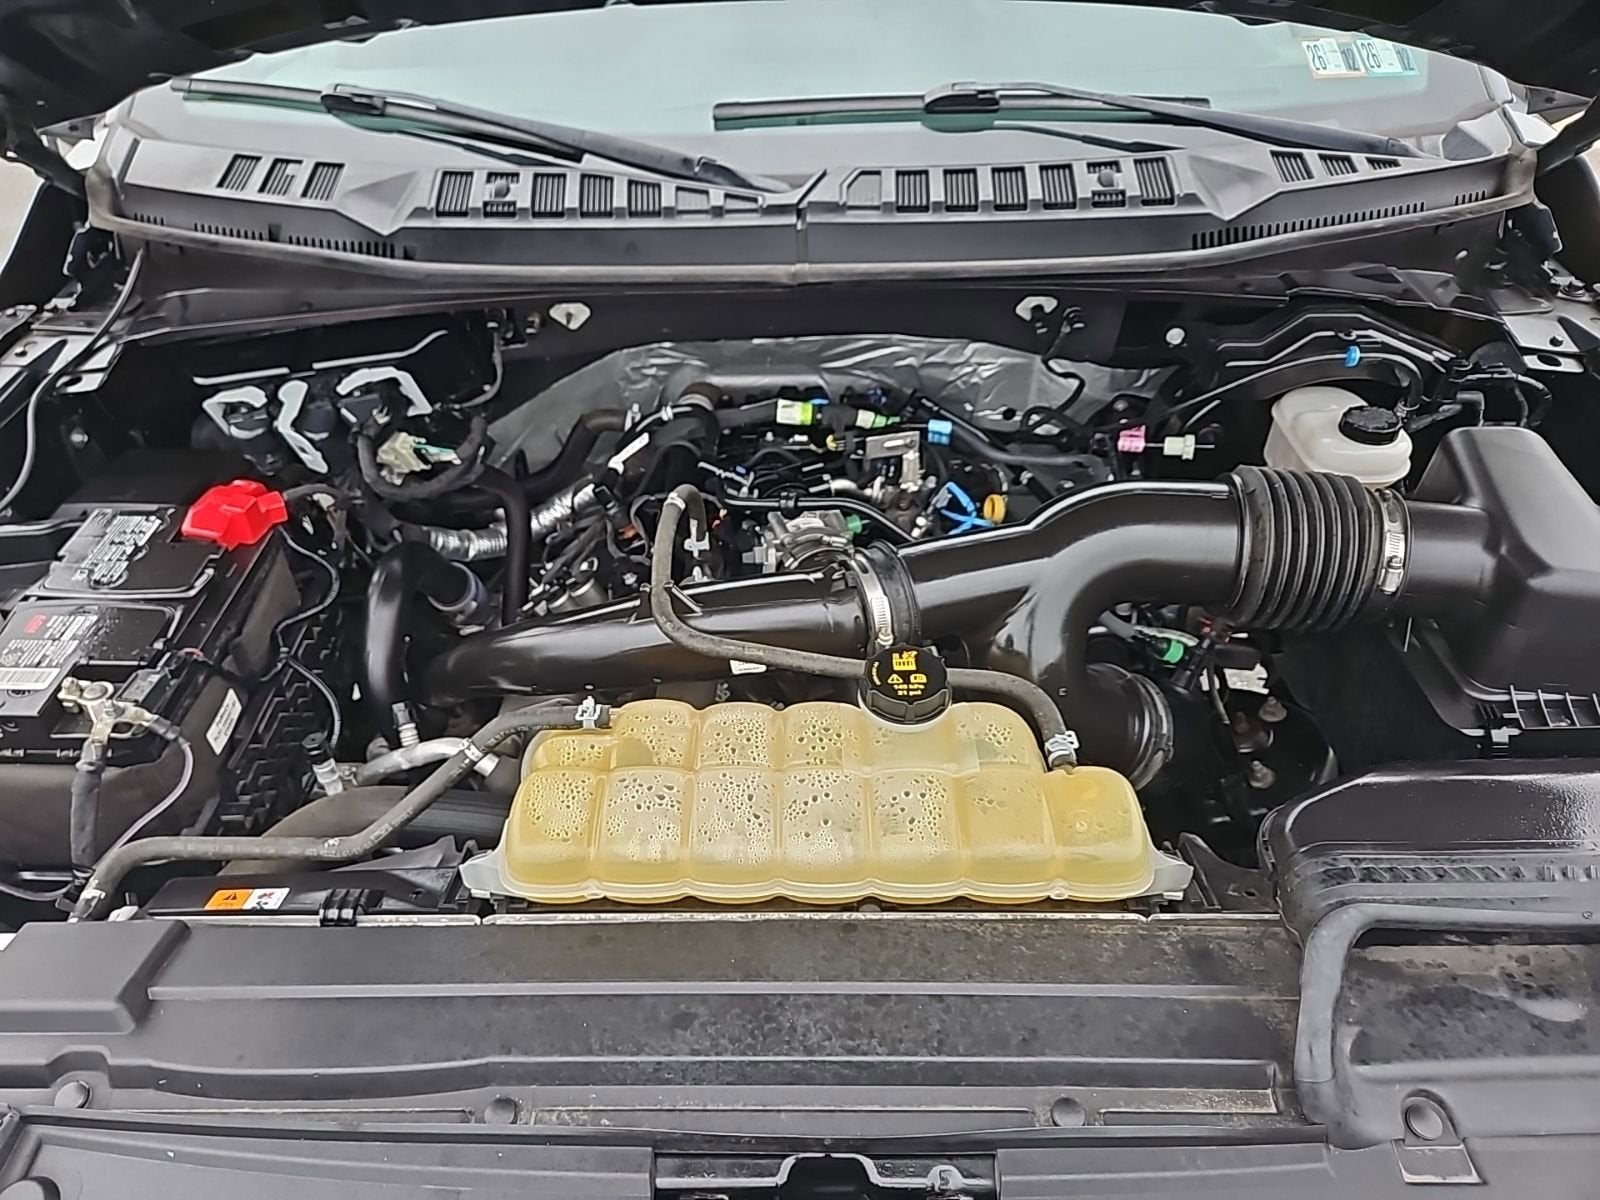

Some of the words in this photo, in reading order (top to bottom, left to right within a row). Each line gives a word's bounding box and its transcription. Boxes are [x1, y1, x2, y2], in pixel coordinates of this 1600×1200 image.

[1306, 44, 1328, 70] 26
[1341, 47, 1361, 71] 12
[1360, 42, 1382, 69] 26
[1395, 47, 1415, 71] 12
